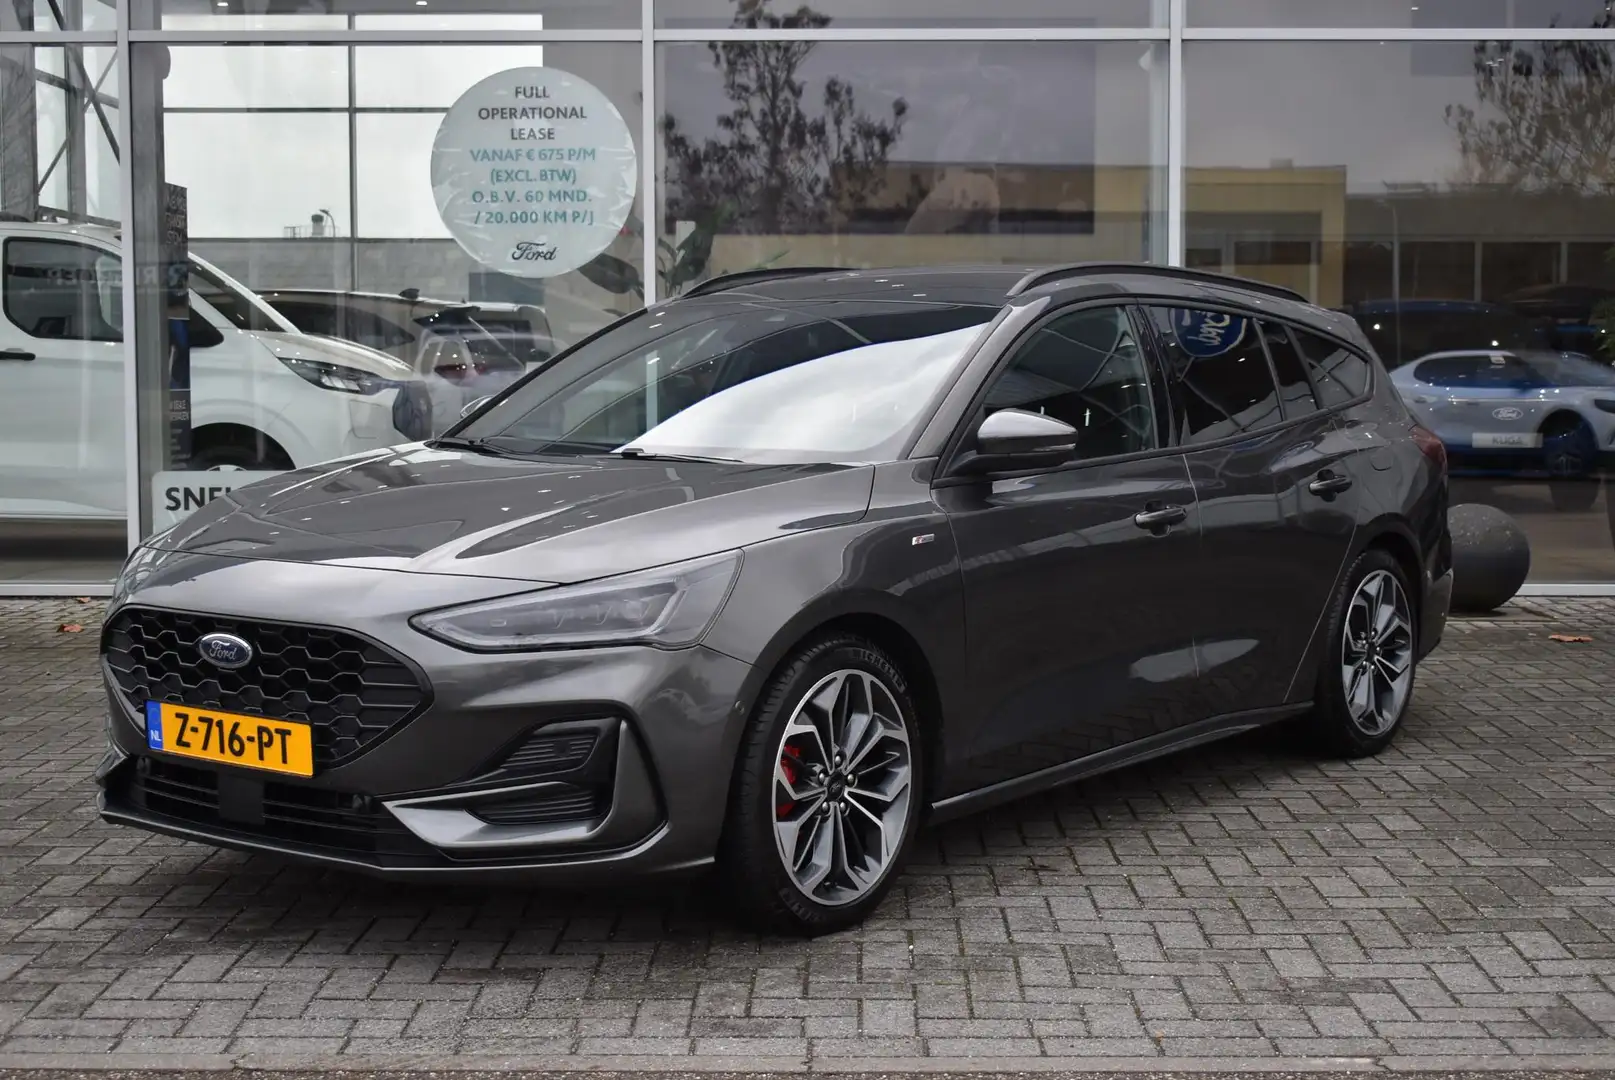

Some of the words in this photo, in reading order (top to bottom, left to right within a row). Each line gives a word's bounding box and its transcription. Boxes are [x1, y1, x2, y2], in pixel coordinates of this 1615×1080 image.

[515, 86, 550, 99] FULL
[478, 106, 587, 120] OPERATIONAL
[510, 128, 555, 140] LEASE
[470, 148, 523, 162] VANAF
[525, 149, 535, 161] €
[538, 148, 565, 161] 675
[567, 148, 596, 161] P/M
[490, 168, 537, 186] (EXCL.
[540, 168, 577, 185] BTW)
[472, 190, 520, 204] O.B.V.
[525, 190, 544, 203] 60
[549, 190, 592, 203] MND.
[485, 211, 539, 224] 20.000
[543, 211, 567, 224] KM
[511, 241, 558, 261] Ford
[165, 486, 231, 511] SN
[209, 640, 238, 660] Ford
[150, 729, 162, 742] NL
[174, 712, 292, 764] Z-716-PT
